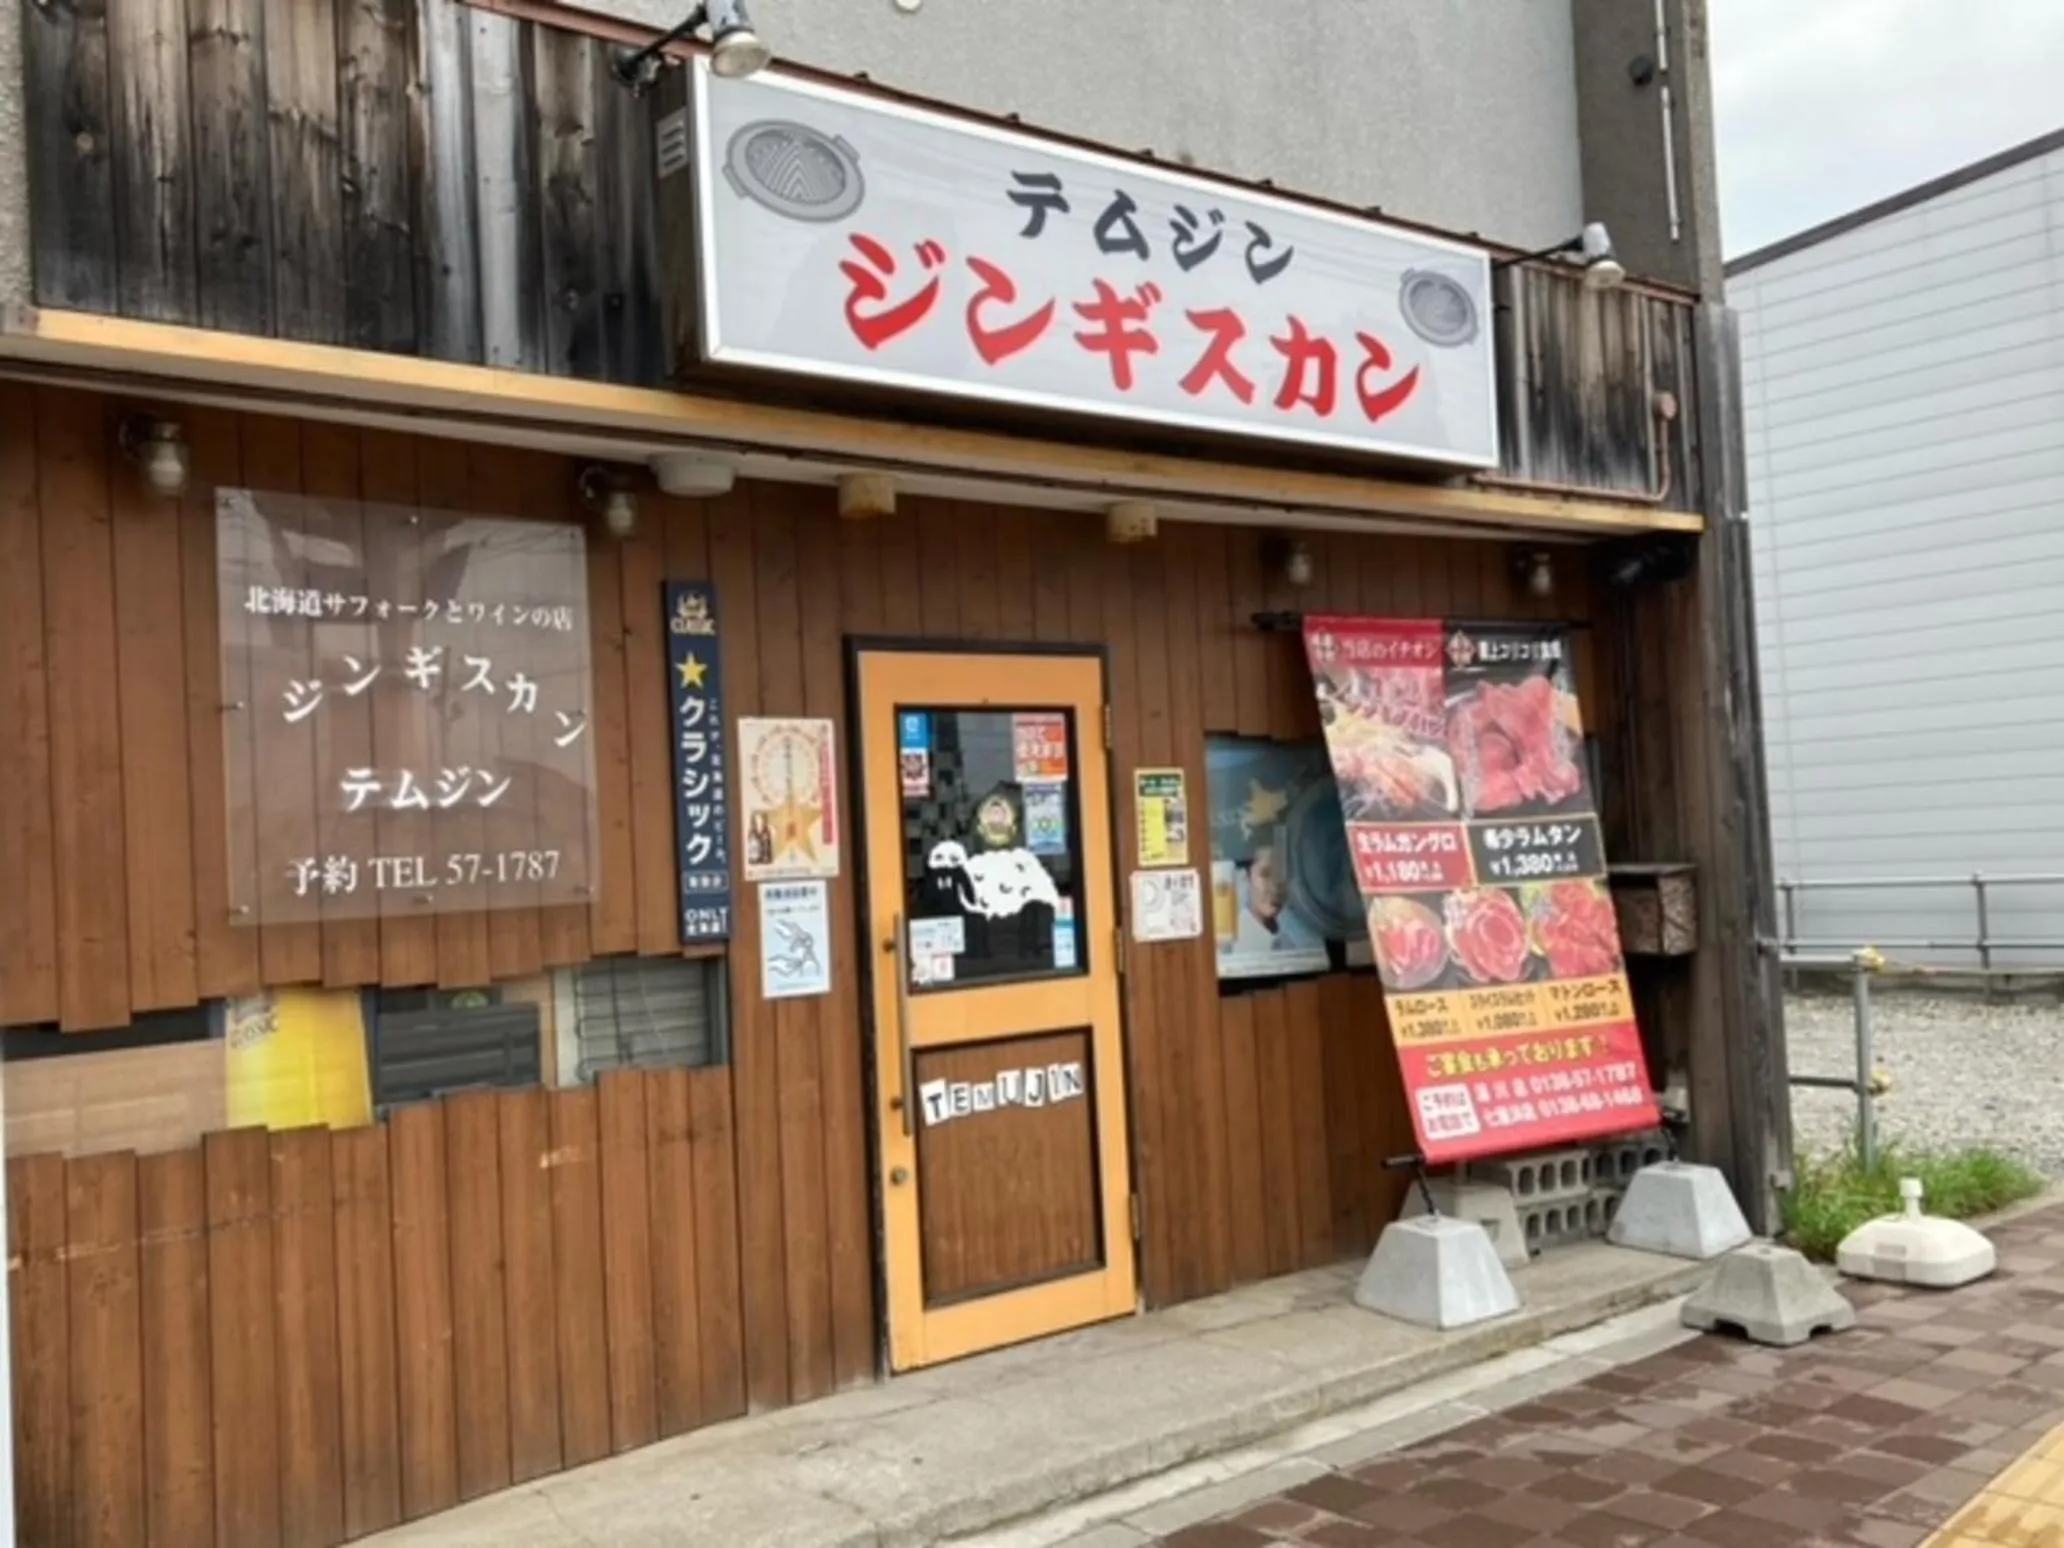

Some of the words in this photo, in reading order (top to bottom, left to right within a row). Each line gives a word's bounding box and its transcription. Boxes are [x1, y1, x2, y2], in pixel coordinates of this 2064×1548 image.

[1006, 168, 1295, 286] テムジン
[838, 232, 1422, 423] ジンギスカン
[244, 585, 574, 632] 北海道サフォークとワインの店
[282, 645, 588, 748] ジンギスカン
[340, 766, 512, 813] テムジン
[678, 695, 713, 866] クラシック
[286, 856, 358, 897] 予約
[367, 855, 438, 890] TEL
[445, 849, 561, 887] 57-1787
